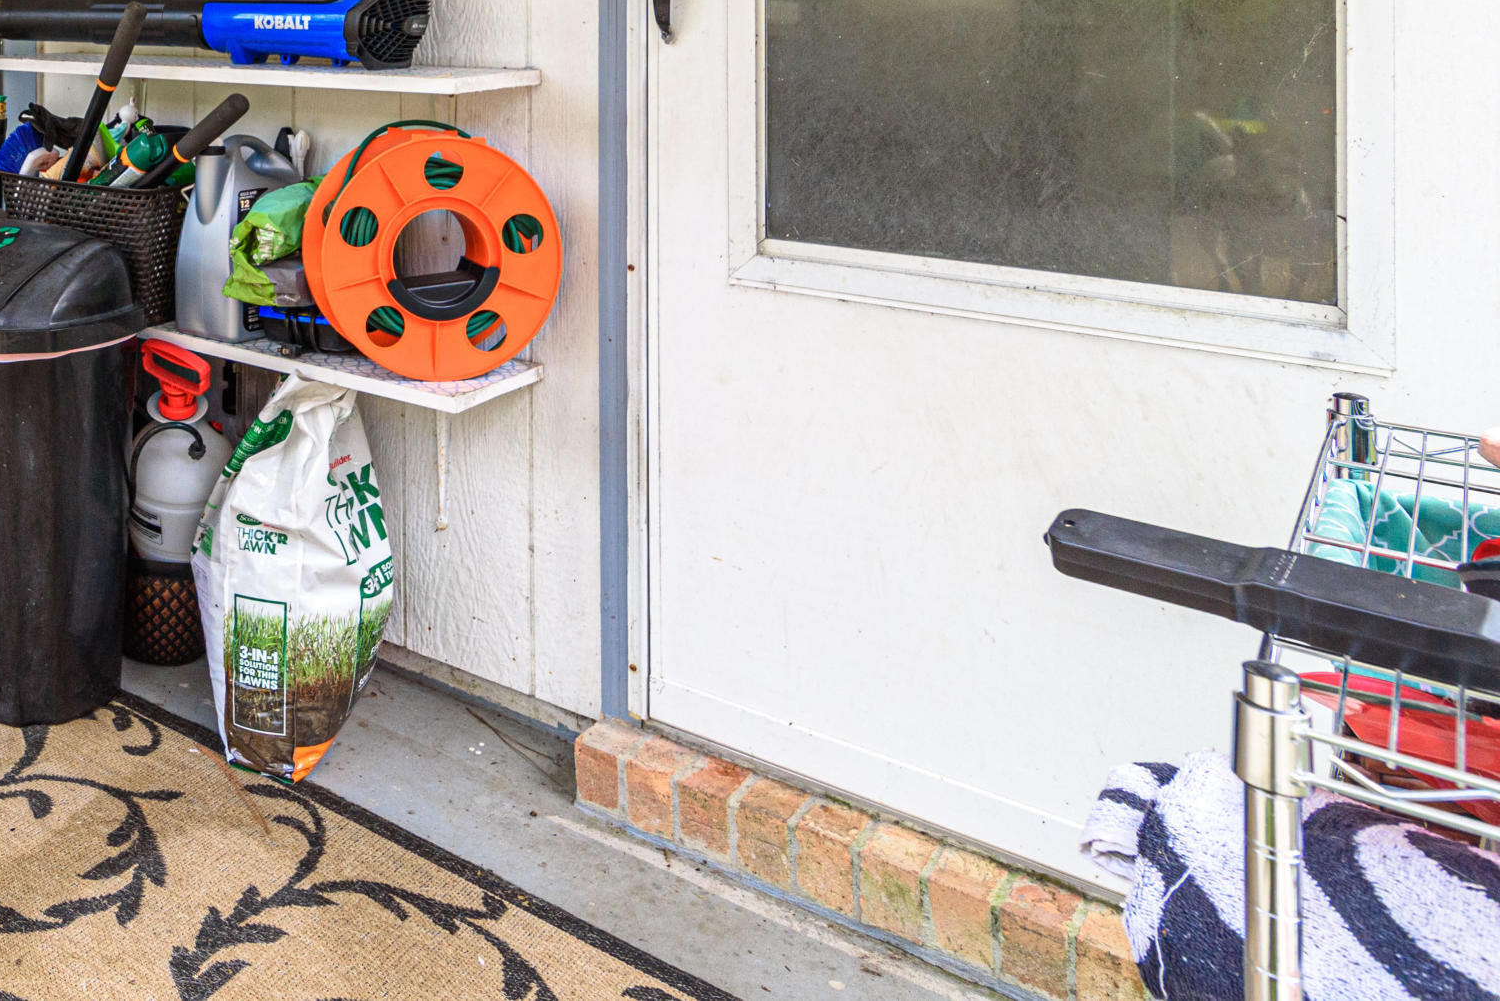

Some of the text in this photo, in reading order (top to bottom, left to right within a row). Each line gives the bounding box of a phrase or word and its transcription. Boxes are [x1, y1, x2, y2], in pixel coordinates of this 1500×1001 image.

[254, 15, 311, 30] KOBALT
[240, 199, 250, 209] 12
[236, 526, 288, 545] THICK'R
[238, 538, 277, 555] LAWN
[239, 645, 279, 665] 3-IN-1
[239, 658, 278, 673] SOLUTION
[239, 665, 278, 681] FOR THIN
[239, 673, 278, 690] LAWNS
